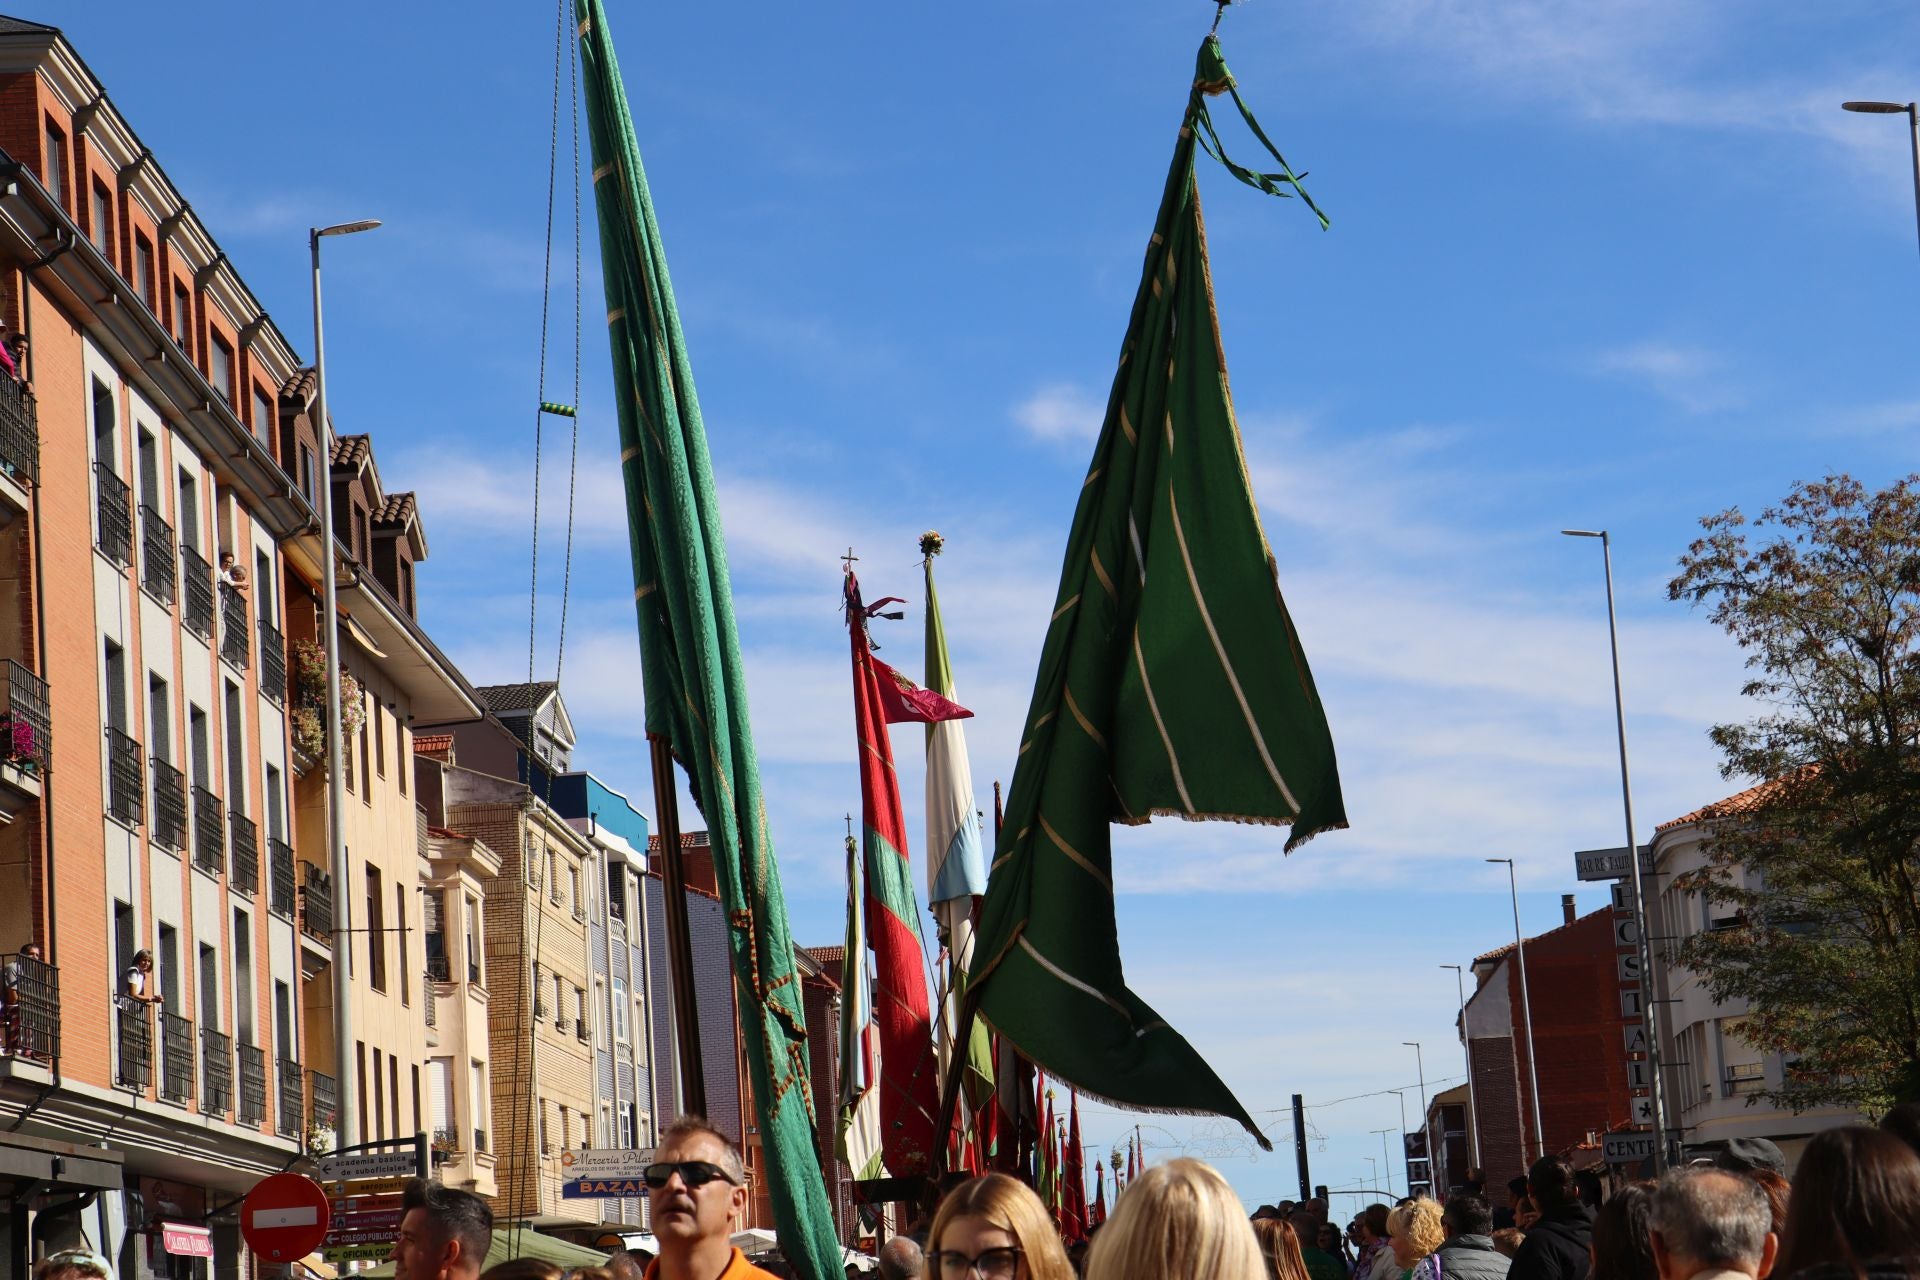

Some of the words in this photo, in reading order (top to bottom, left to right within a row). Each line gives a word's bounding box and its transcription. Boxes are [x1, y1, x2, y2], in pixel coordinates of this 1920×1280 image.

[1576, 858, 1594, 873] BAR
[1595, 853, 1651, 872] RESTAURTE
[1606, 1139, 1677, 1156] CENTRL
[335, 1157, 375, 1167] academia
[622, 1150, 652, 1164] Pilar
[355, 1164, 407, 1175] suboficiales
[360, 1181, 402, 1192] aeropuert
[341, 1233, 367, 1243] COLEGIO
[342, 1248, 373, 1259] OFICINA
